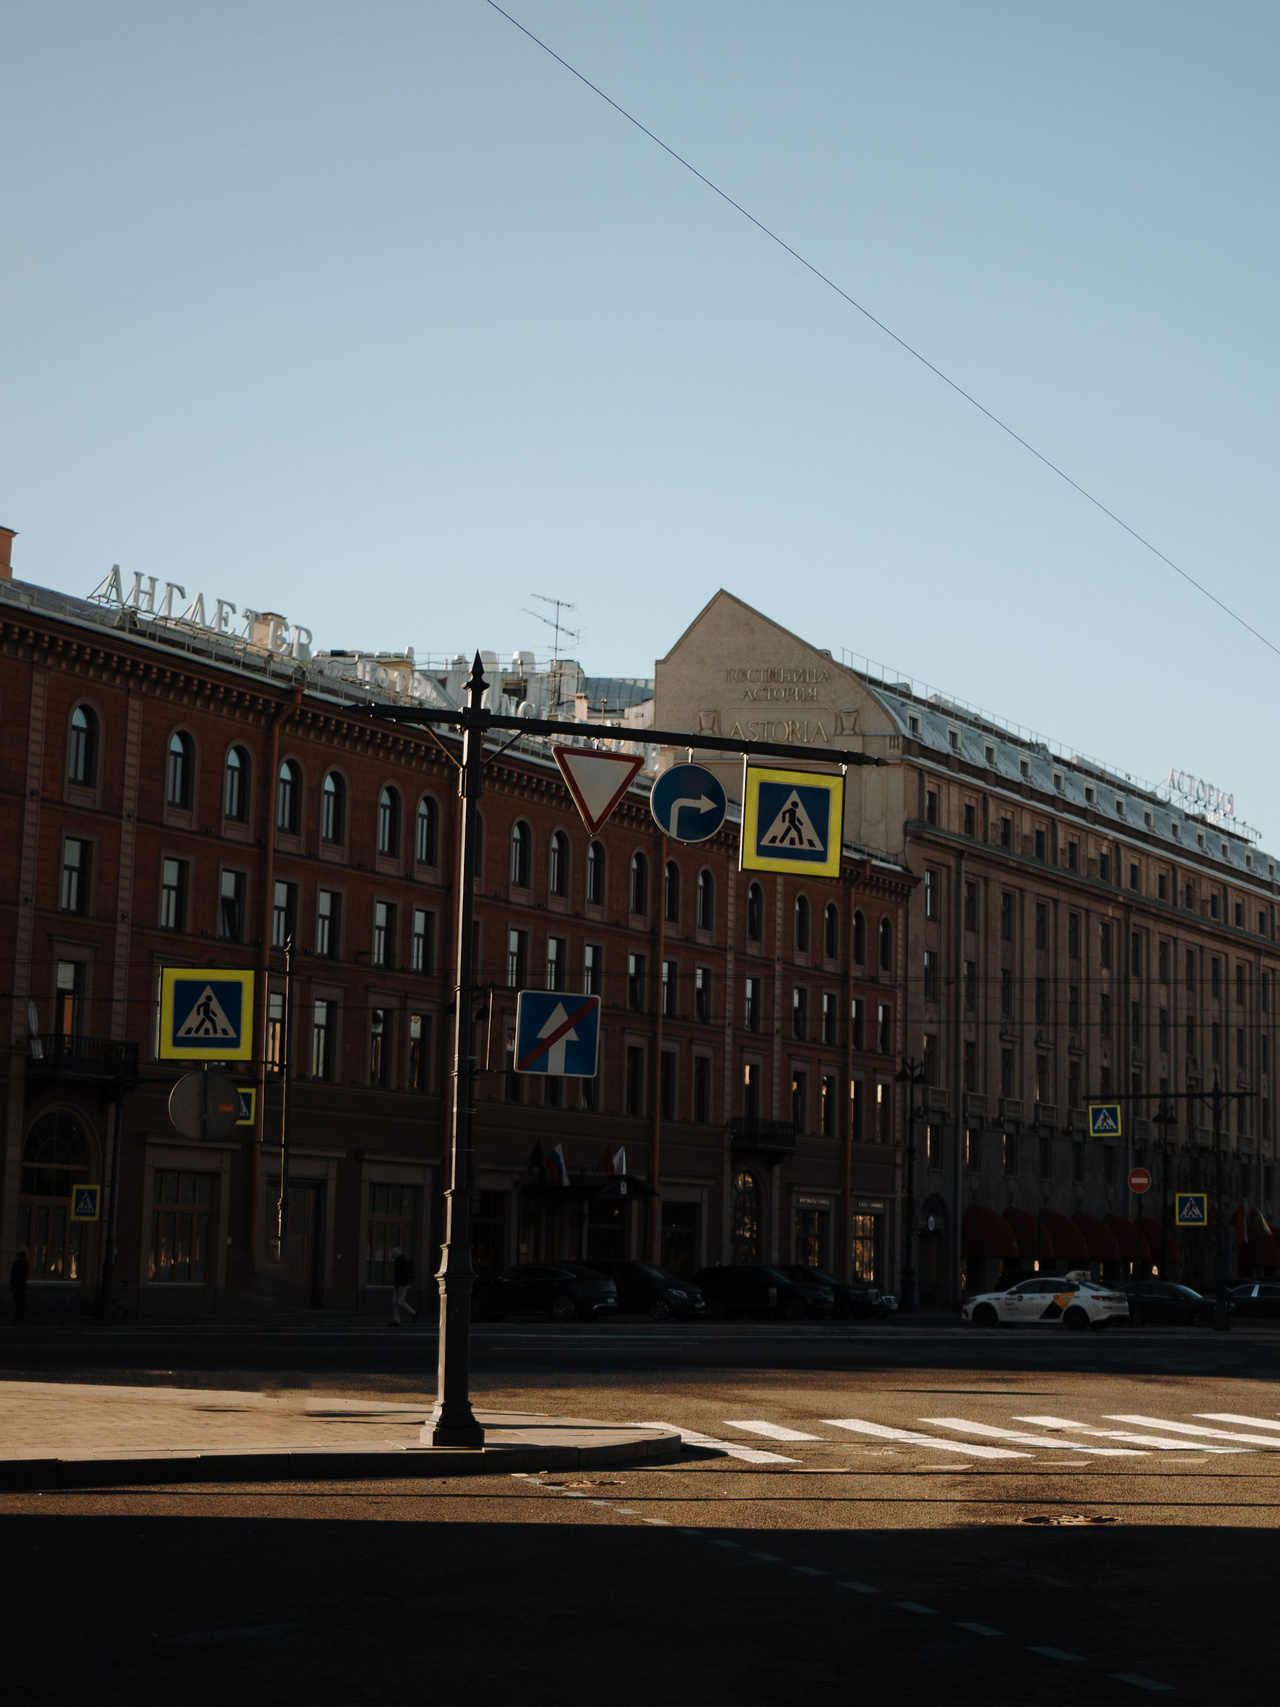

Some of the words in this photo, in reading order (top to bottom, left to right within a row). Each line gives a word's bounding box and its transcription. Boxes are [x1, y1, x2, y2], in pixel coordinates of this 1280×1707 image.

[101, 564, 313, 661] АНГЛЕТЕР
[726, 668, 832, 684] ГОСТИНИЦА
[741, 687, 819, 702] АСТОРИЯ
[730, 720, 829, 743] ASTORIA
[1167, 767, 1234, 815] АСТОРИЯ
